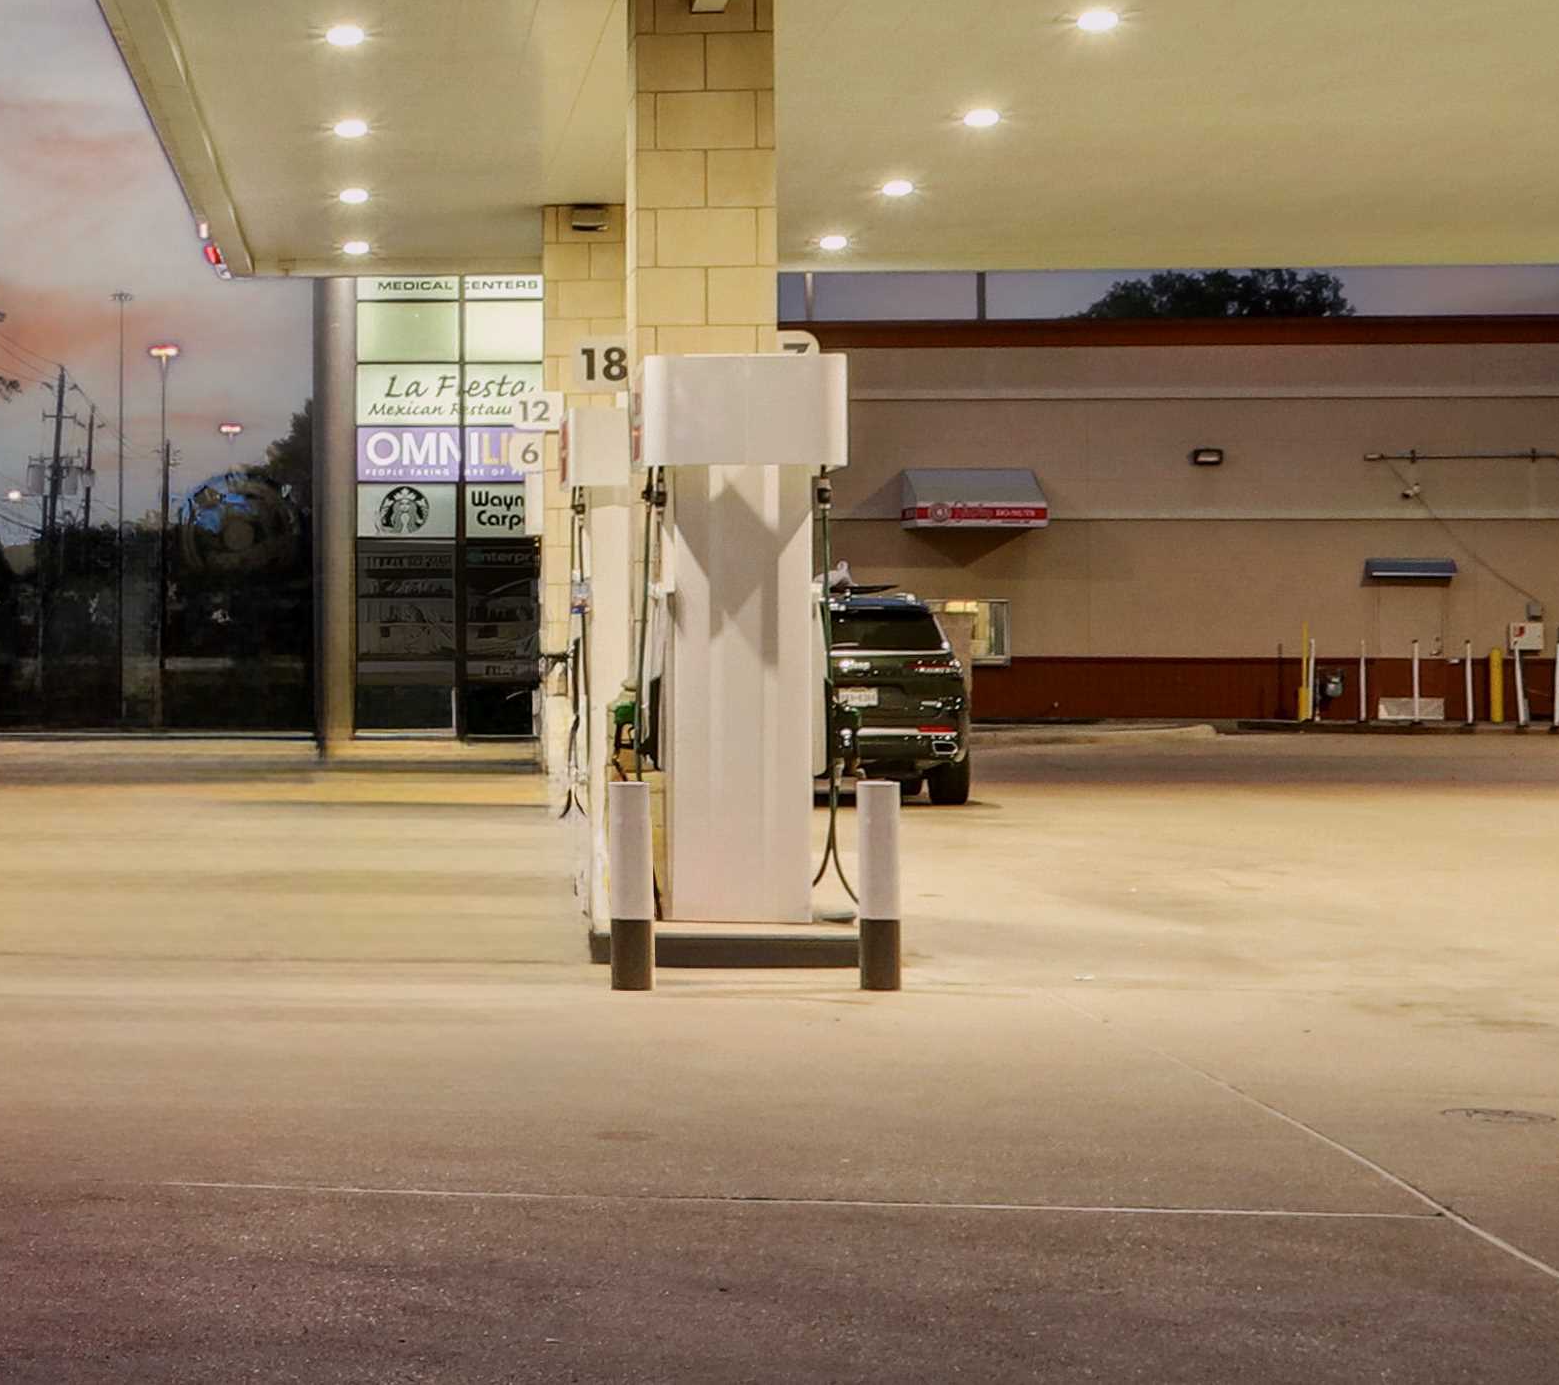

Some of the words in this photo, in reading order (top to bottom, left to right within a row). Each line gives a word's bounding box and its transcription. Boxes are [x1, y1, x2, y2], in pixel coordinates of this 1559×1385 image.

[378, 281, 453, 291] MEDICAL
[581, 347, 628, 381] 18
[384, 374, 428, 398] La
[368, 400, 446, 417] Mexican
[519, 400, 551, 423] 12
[366, 432, 510, 467] OMNILI
[521, 442, 539, 465] 6
[365, 468, 404, 477] PEOPLE
[410, 468, 450, 477] TAKING
[464, 468, 485, 477] ARE
[471, 490, 525, 511] Wayn
